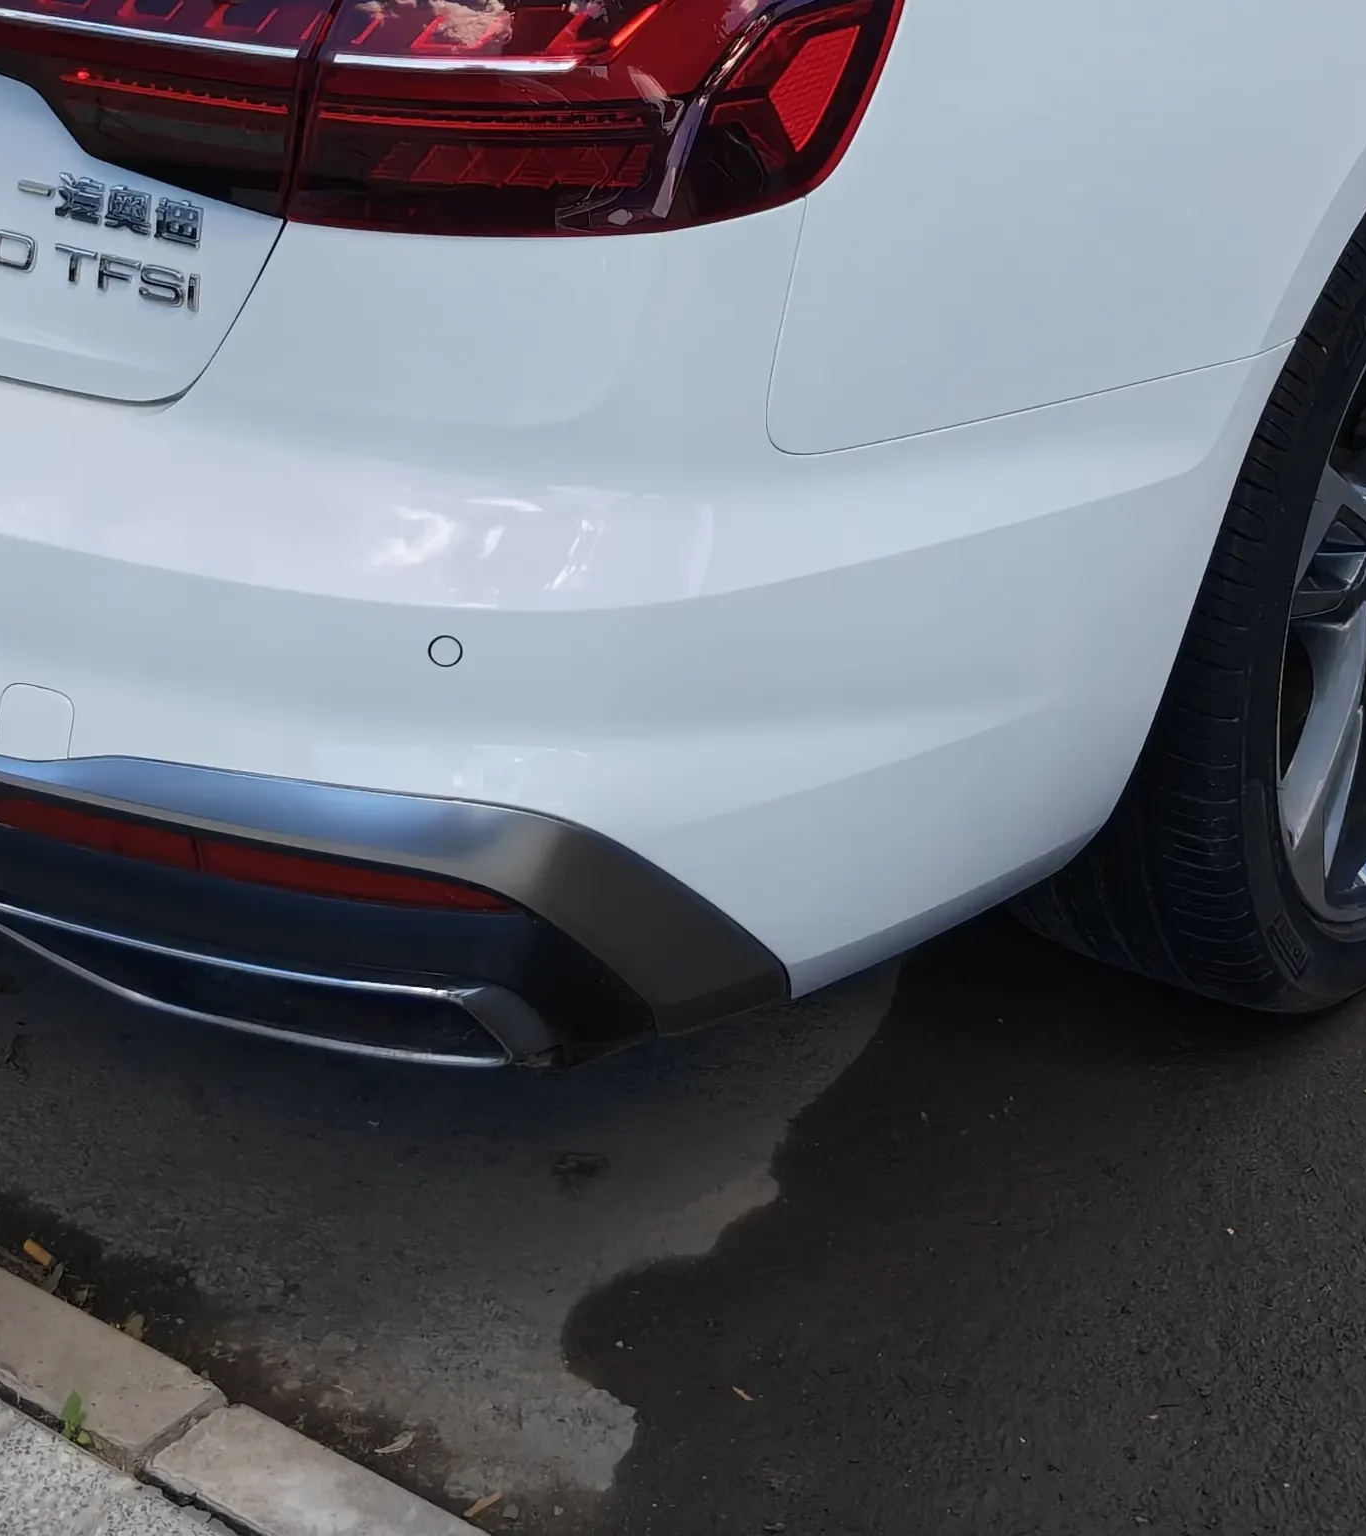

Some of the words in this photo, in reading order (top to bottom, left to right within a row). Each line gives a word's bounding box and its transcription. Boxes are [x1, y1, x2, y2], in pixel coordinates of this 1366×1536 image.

[17, 171, 205, 250] 一汽奥迪
[54, 241, 202, 314] TFSI
